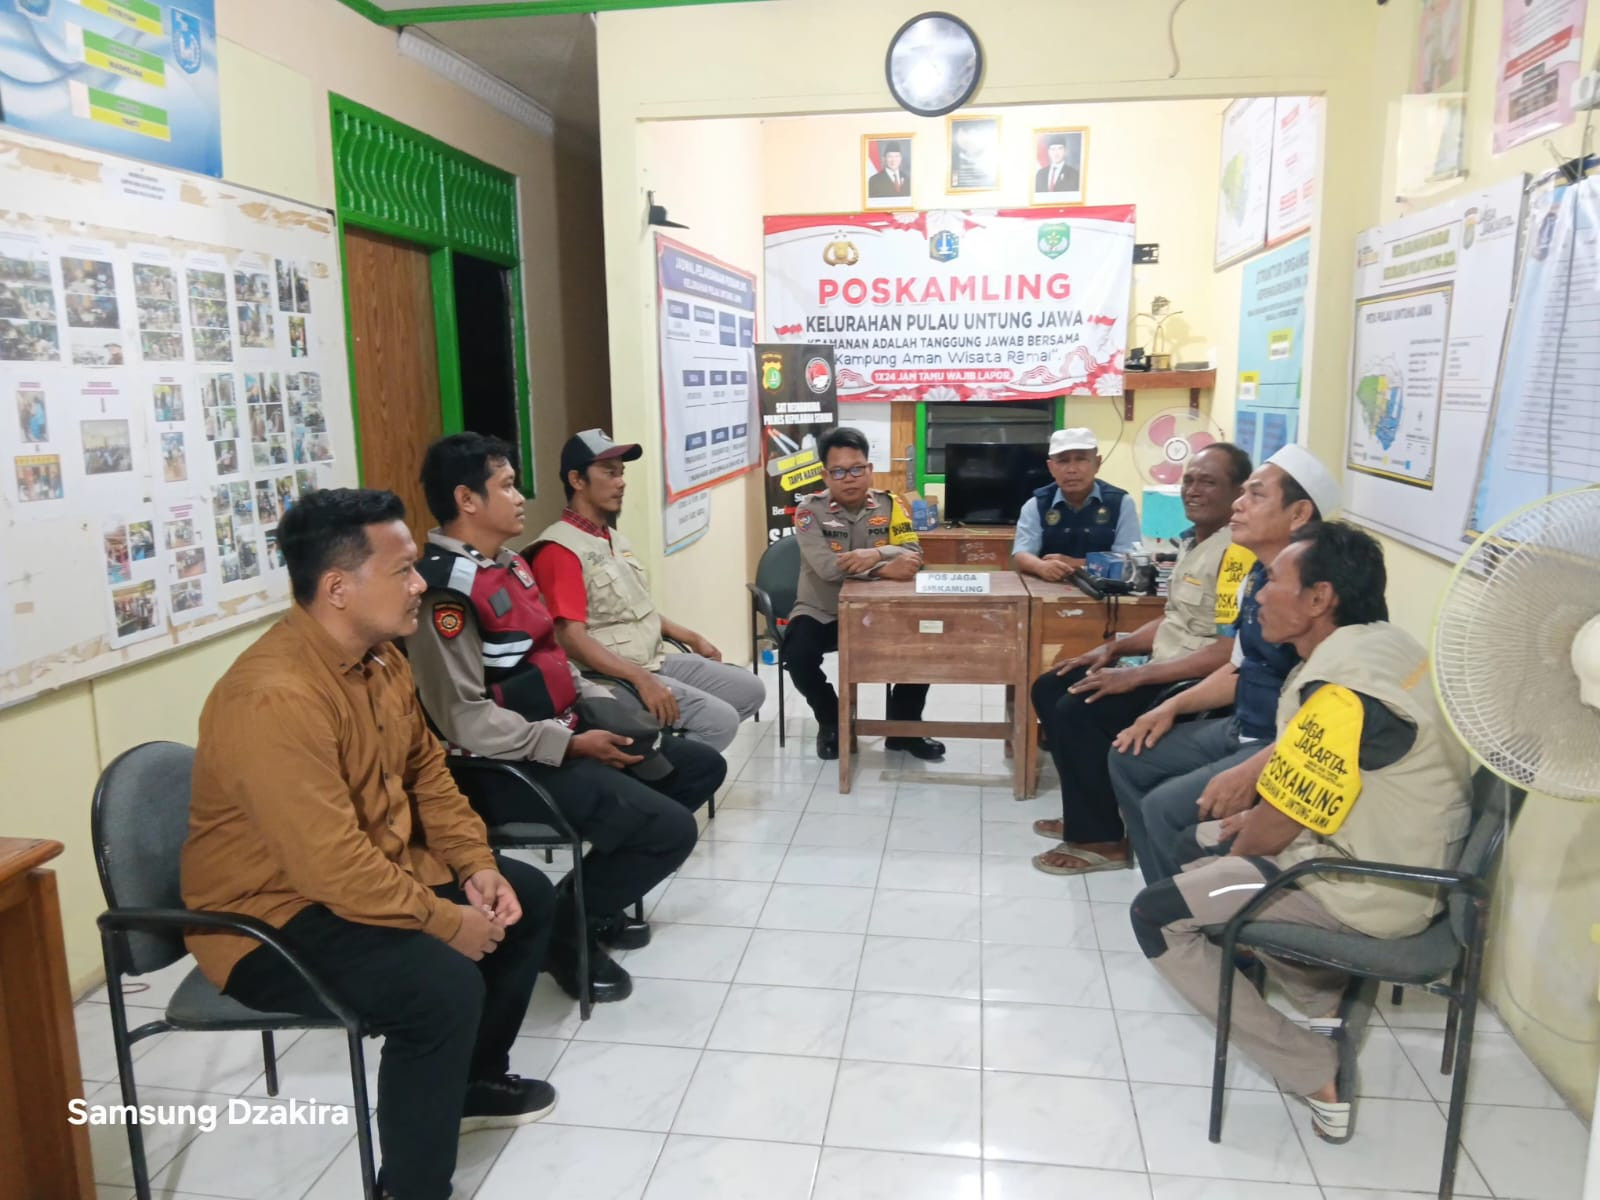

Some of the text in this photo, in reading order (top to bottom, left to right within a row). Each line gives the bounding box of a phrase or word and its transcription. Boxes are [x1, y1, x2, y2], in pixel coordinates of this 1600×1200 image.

[818, 273, 1070, 305] POSKAMLING
[806, 310, 1083, 332] KELURAHAN PULAU UNTUNG JAWA
[872, 337, 917, 349] ADALAH
[920, 336, 981, 348] TANGGUNG
[985, 335, 1024, 347] JAWAB
[1027, 332, 1080, 346] BERSAMA
[833, 353, 897, 367] Kampung
[902, 352, 942, 364] Aman
[947, 350, 1001, 363] Wisata
[898, 371, 917, 381] JAM
[918, 371, 944, 381] TAMU
[946, 370, 977, 380] WAJIB
[977, 370, 1011, 380] LAPOR
[1298, 713, 1325, 743] JAGA
